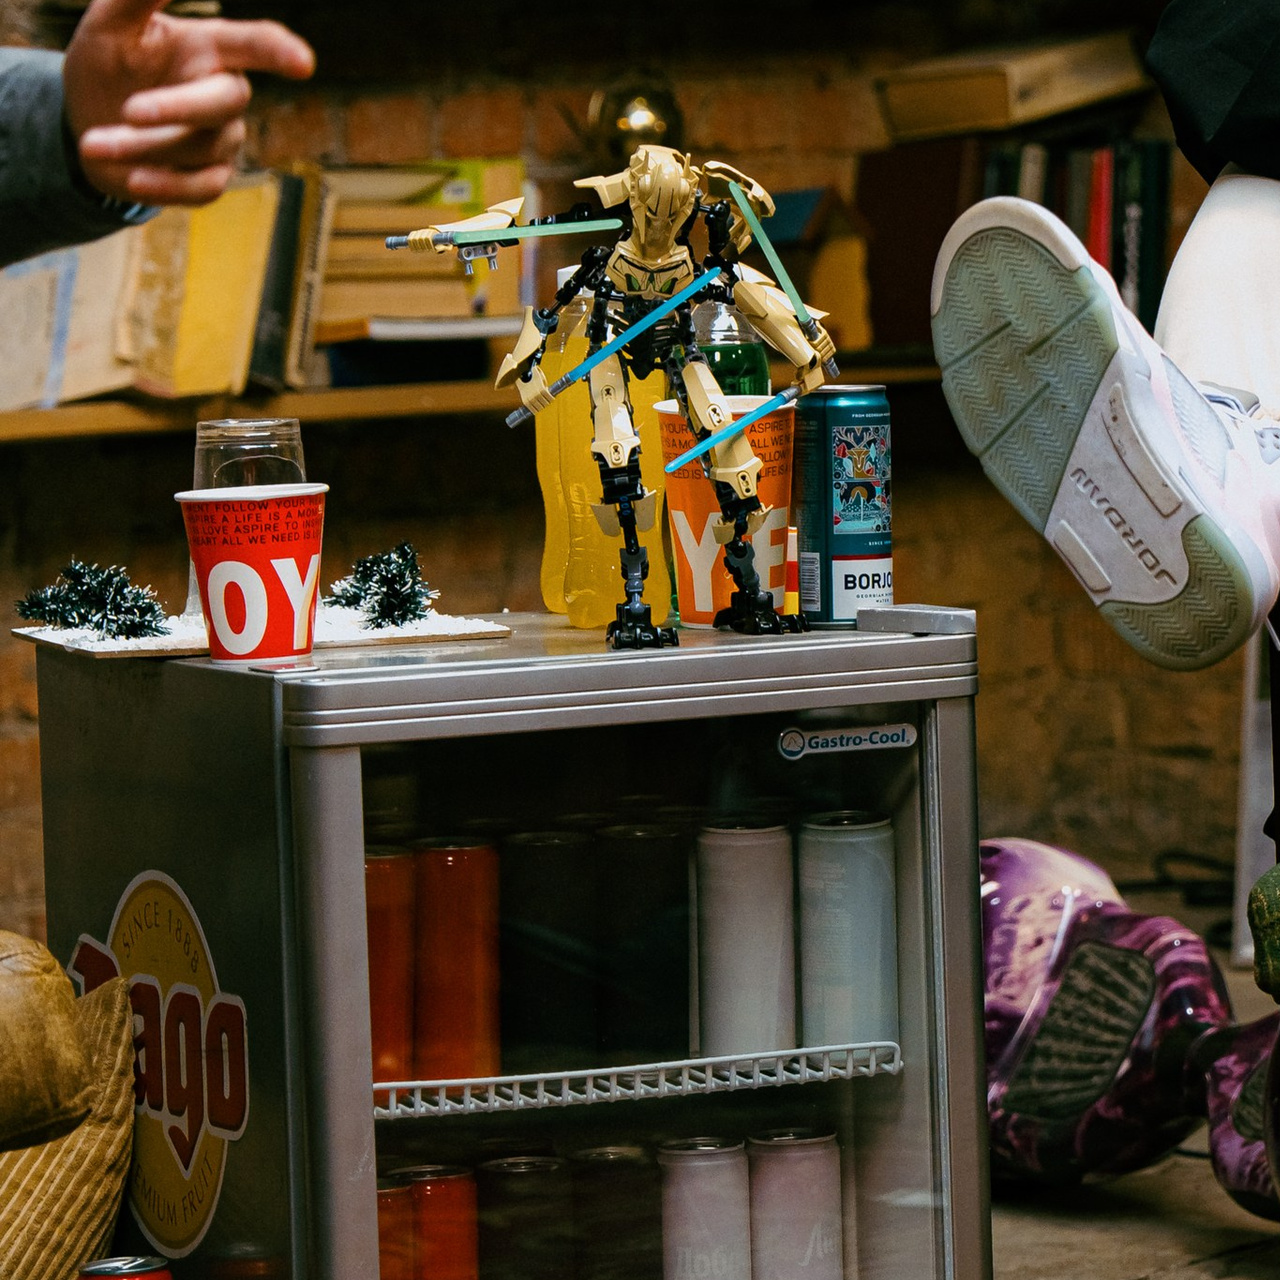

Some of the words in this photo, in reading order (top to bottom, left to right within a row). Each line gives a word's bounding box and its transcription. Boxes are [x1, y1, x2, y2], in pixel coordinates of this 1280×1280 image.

[749, 420, 784, 434] ASPIRE
[750, 438, 769, 449] ALL
[771, 435, 784, 446] WE
[755, 450, 786, 463] OLLOW
[215, 502, 269, 513] FOLLOW
[275, 499, 305, 509] YOUR
[221, 515, 229, 523] A
[235, 512, 264, 523] LIFE
[269, 511, 280, 521] IS
[285, 511, 293, 519] A
[202, 525, 229, 536] LOVE
[234, 523, 279, 534] ASPIRE
[285, 521, 299, 530] TO
[1069, 468, 1176, 587] JORDAN
[222, 536, 242, 546] ALL
[248, 535, 266, 545] WE
[271, 532, 300, 543] NEED
[303, 531, 311, 540] IS
[808, 728, 906, 750] Gastro-Cool
[121, 901, 160, 959] SINCE
[167, 909, 199, 974] 1888
[181, 1149, 214, 1224] FRUIT
